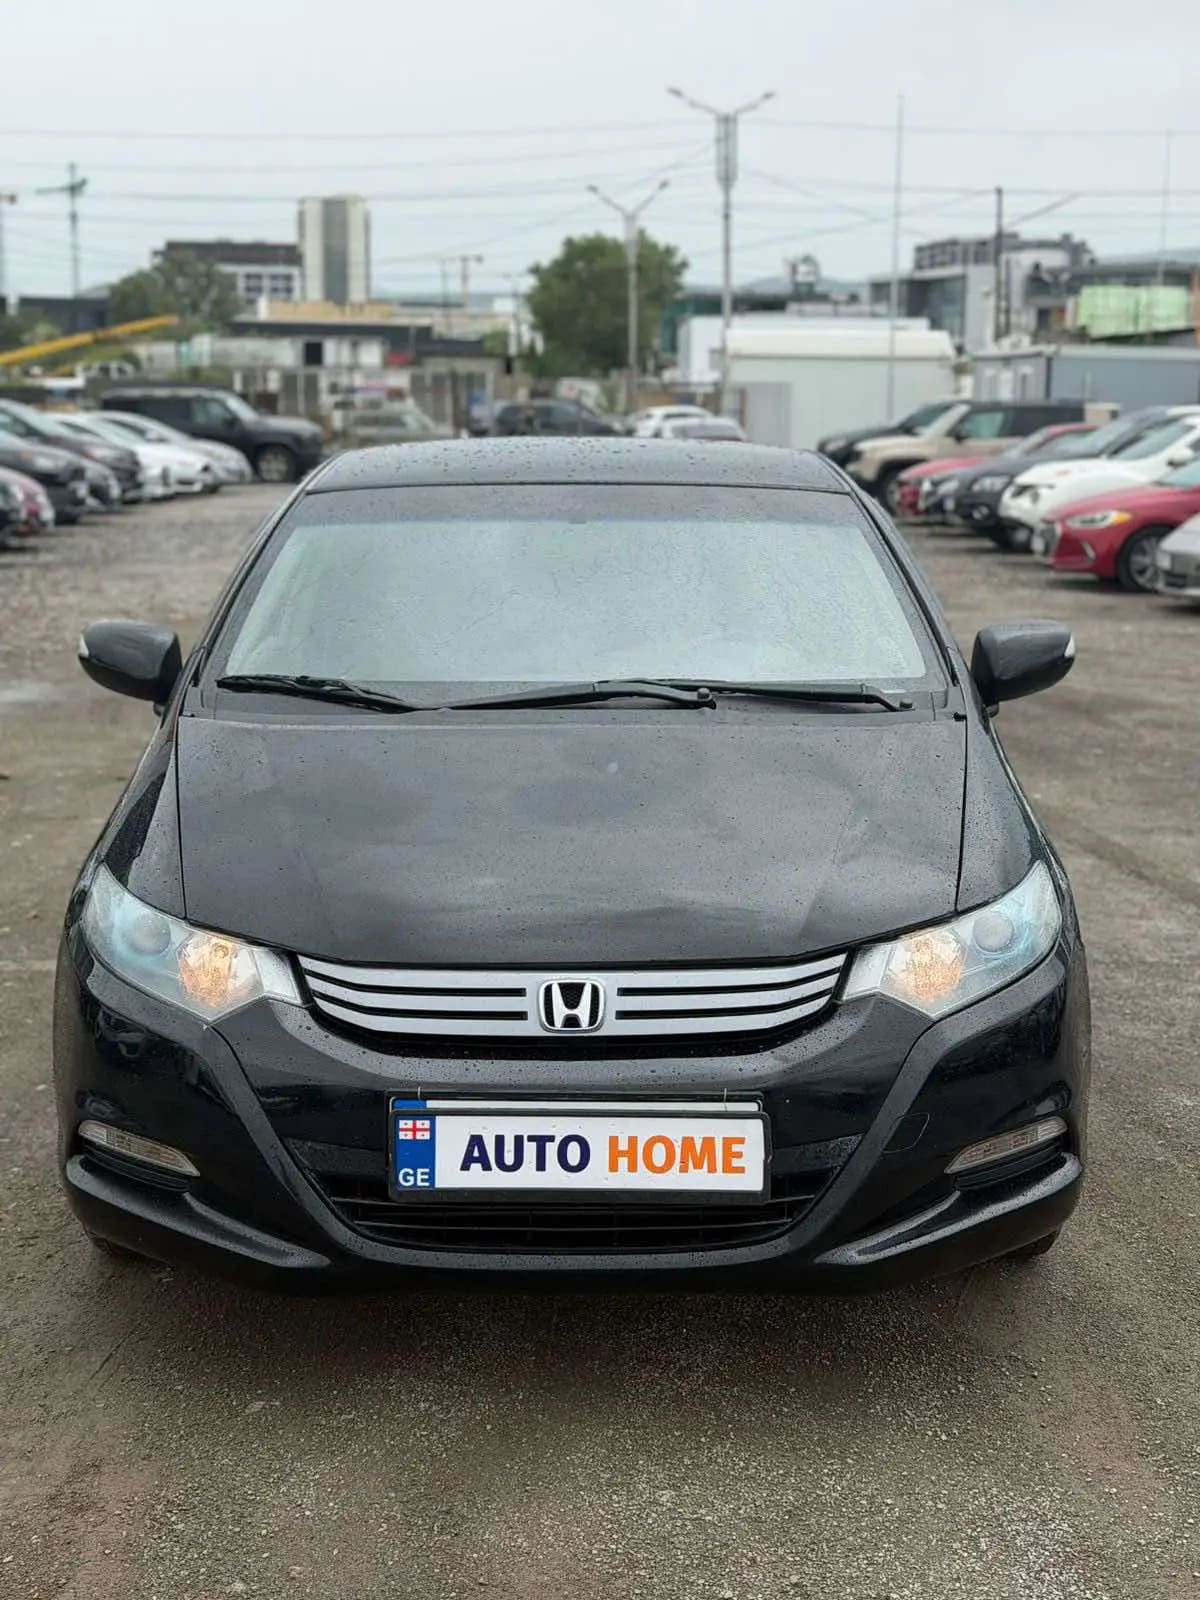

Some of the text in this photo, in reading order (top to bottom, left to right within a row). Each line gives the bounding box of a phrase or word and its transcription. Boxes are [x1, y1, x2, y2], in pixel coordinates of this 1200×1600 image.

[460, 1134, 746, 1174] AUTO HOME
[398, 1167, 430, 1187] GE
